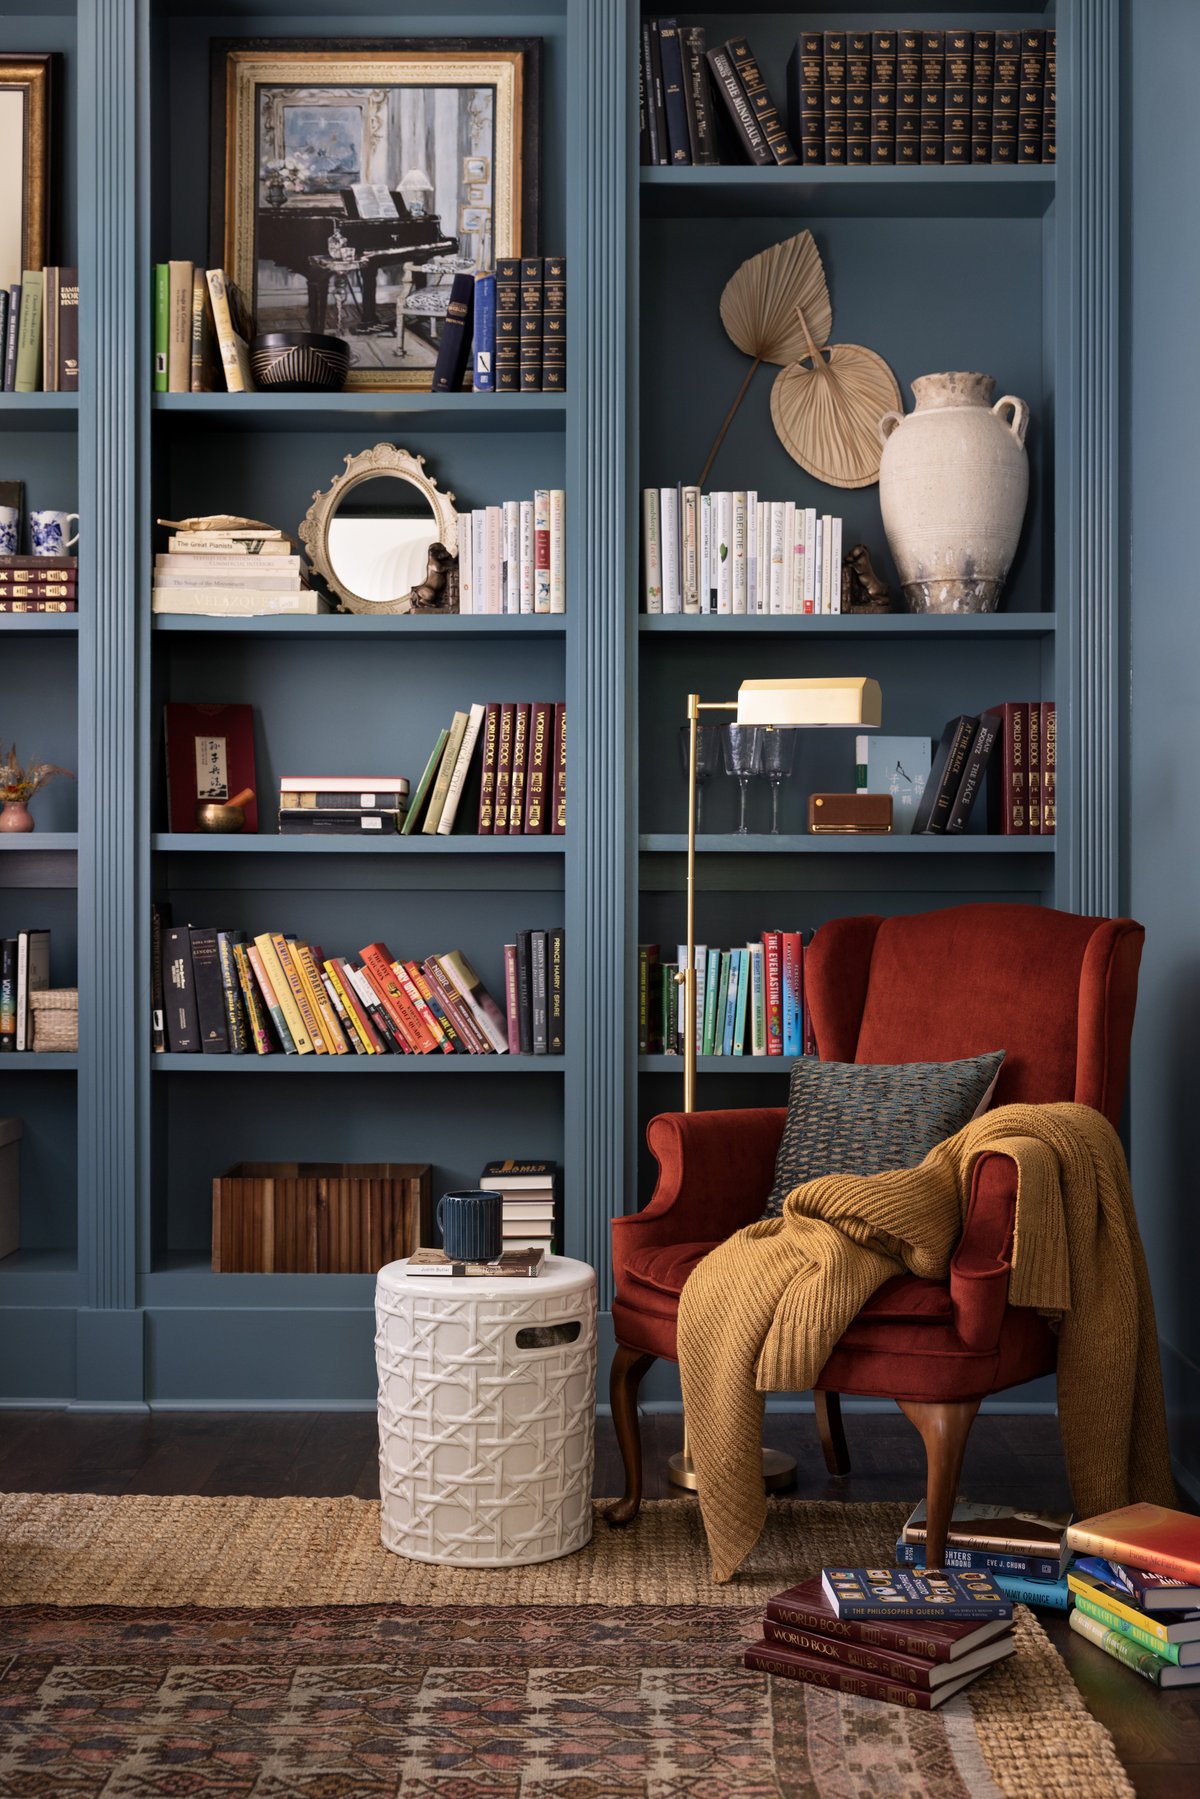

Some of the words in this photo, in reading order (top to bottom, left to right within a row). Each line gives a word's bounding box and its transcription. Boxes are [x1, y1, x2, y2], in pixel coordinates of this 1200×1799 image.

[690, 56, 699, 69] The
[691, 72, 701, 98] Filming
[724, 77, 739, 96] THE
[694, 99, 703, 108] of
[696, 109, 704, 119] the
[697, 120, 707, 137] West
[731, 96, 763, 145] MINOTAUR
[192, 288, 203, 340] WILDERNESS
[648, 491, 657, 541] Groundskeeping
[735, 506, 744, 549] LIBERTIE
[209, 541, 233, 549] Pianists
[486, 711, 495, 740] WORLD
[501, 711, 510, 741] WORLD
[516, 711, 525, 741] WORLD
[535, 711, 544, 741] WORLD
[964, 723, 972, 733] AT
[1013, 711, 1021, 740] WORLD
[1030, 711, 1038, 740] WORLD
[1046, 711, 1056, 740] WORLD
[460, 723, 474, 765] MUSICAL
[960, 735, 968, 748] THE
[975, 728, 987, 753] KOONTZ
[982, 733, 993, 752] DEAN
[485, 742, 494, 765] BOOK
[500, 742, 509, 765] BOOK
[515, 742, 524, 765] BOOK
[534, 742, 543, 765] BOOK
[953, 751, 963, 772] TRACK
[1013, 742, 1021, 765] BOOK
[1030, 742, 1038, 765] BOOK
[1046, 742, 1056, 765] BOOK
[450, 768, 462, 795] STYLE
[969, 763, 979, 777] THE
[962, 780, 975, 803] FACE
[768, 935, 777, 949] THE
[368, 956, 383, 980] WOUNDS
[372, 952, 381, 963] THE
[380, 965, 389, 976] FIVE
[277, 941, 290, 965] MEMPHIS
[289, 973, 299, 986] TARA
[299, 997, 317, 1037] STRINGFELLOW
[299, 951, 328, 1005] AFTERPARTIES
[393, 965, 408, 983] STAY
[404, 981, 419, 1000] WITH
[414, 999, 425, 1010] ME
[768, 953, 779, 1004] EVERLASTING
[2, 979, 10, 1003] WOMAN
[409, 966, 419, 977] THE
[439, 1015, 450, 1028] JANE
[446, 1028, 456, 1038] PEK
[1, 1012, 9, 1030] LIGHT
[396, 1001, 409, 1020] VALDEZ
[409, 1022, 421, 1039] QUADE
[945, 1552, 972, 1562] GHTERS
[987, 1559, 998, 1567] EVE
[1007, 1561, 1026, 1570] CHUNG
[1129, 1549, 1148, 1561] Fiona
[1023, 1592, 1050, 1604] ORANGE
[777, 1608, 817, 1627] WORLD
[819, 1619, 852, 1635] BOOK
[867, 1608, 914, 1616] PHILOSOPHER
[916, 1608, 945, 1616] QUEENS
[772, 1629, 809, 1647] WORLD
[811, 1640, 840, 1656] BOOK
[755, 1659, 796, 1676] WORLD
[798, 1668, 830, 1684] BOOK
